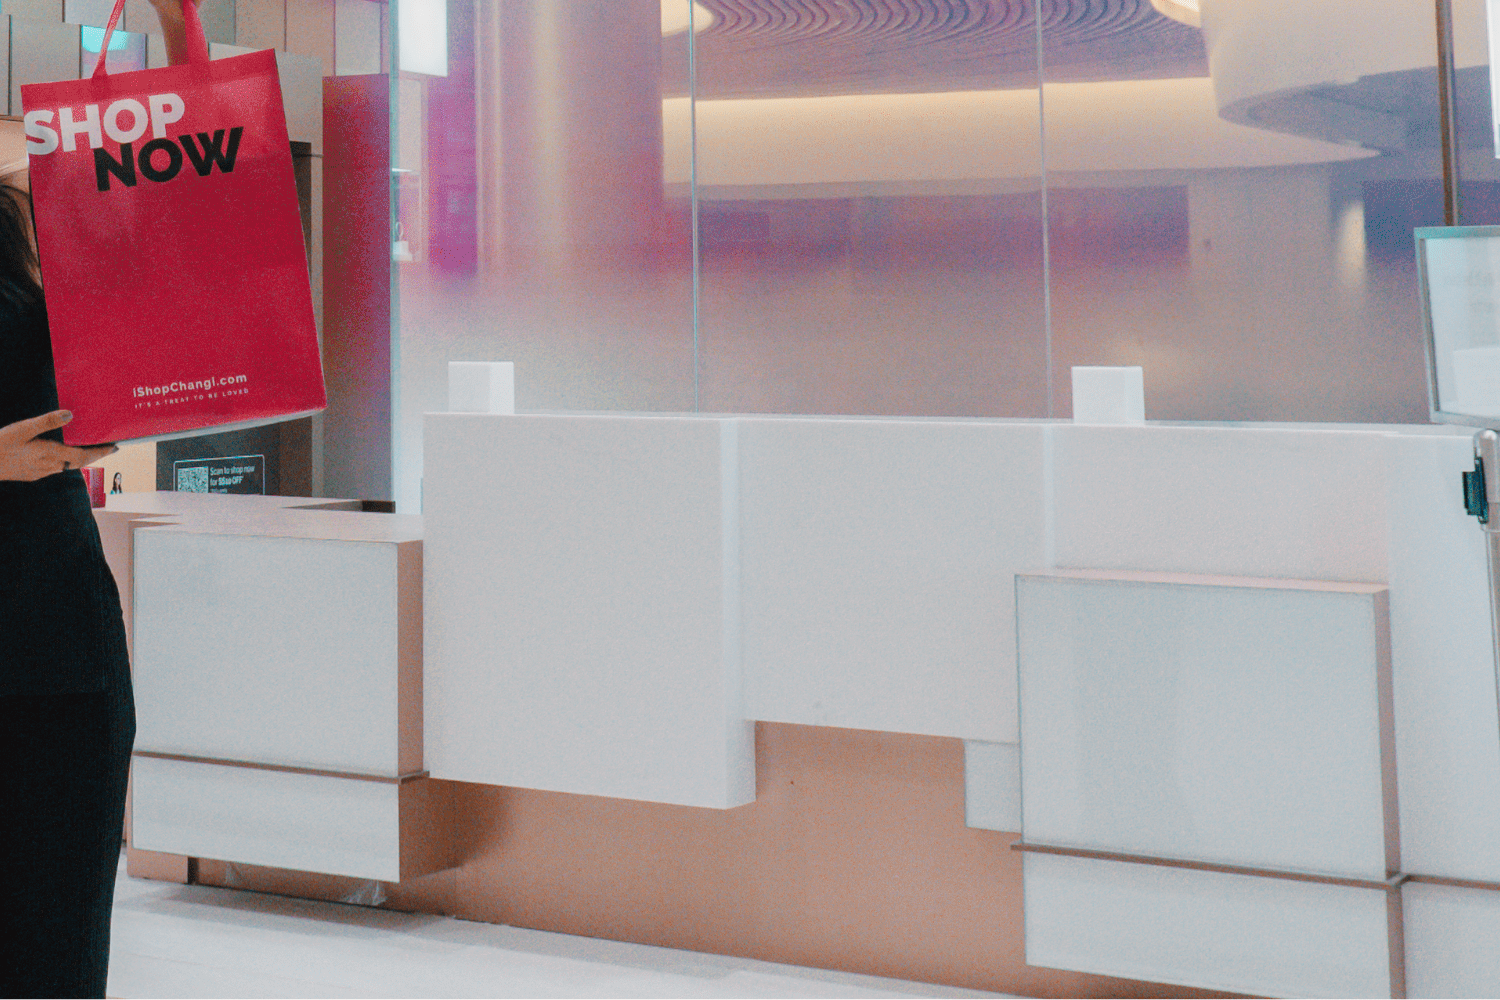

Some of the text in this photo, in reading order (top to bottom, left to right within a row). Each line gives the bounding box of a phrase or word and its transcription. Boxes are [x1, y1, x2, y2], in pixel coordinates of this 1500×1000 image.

[24, 93, 185, 155] SHOP
[94, 127, 244, 192] NOW
[133, 374, 248, 398] iShopChangi.com
